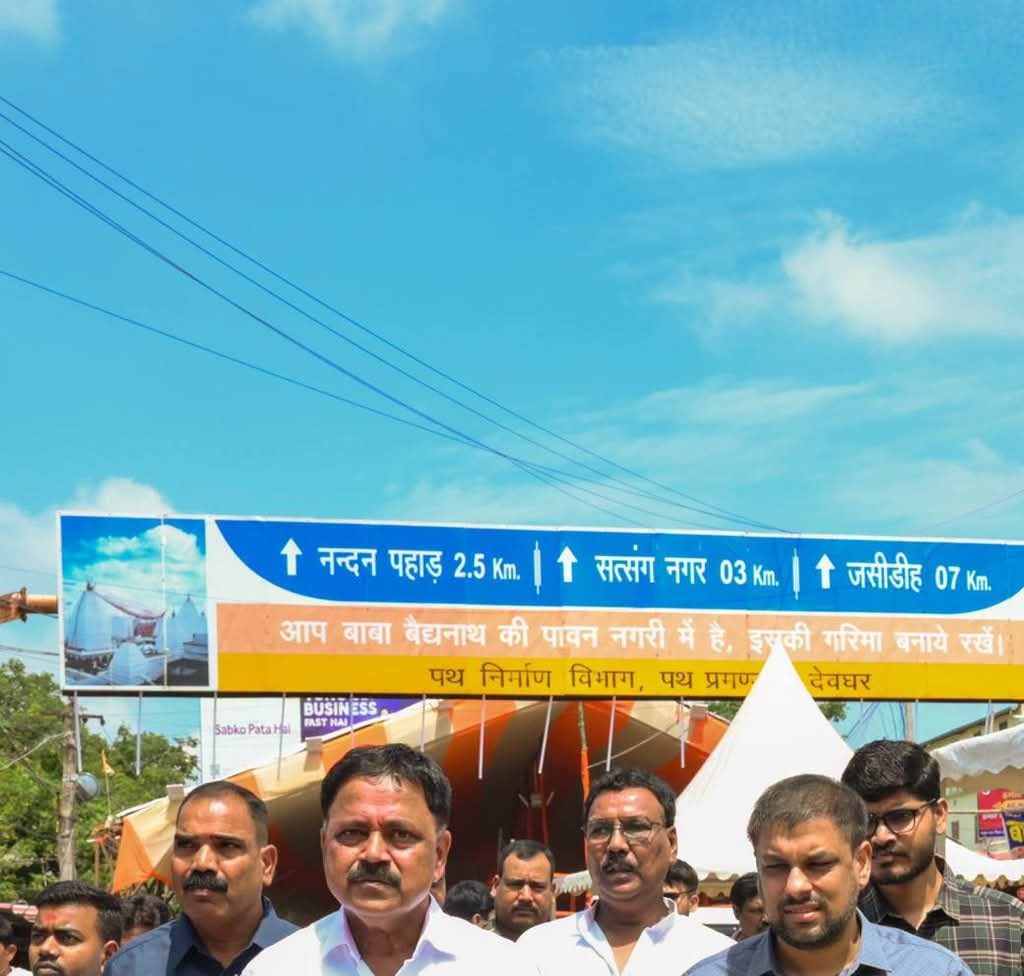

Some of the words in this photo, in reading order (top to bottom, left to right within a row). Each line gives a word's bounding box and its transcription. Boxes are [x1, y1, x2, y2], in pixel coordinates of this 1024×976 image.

[317, 547, 378, 577] नन्दन
[388, 548, 443, 584] पहाड़
[453, 552, 486, 579] 2.5
[492, 558, 521, 580] Km.
[594, 544, 656, 584] सत्संग
[665, 556, 708, 584] नगर
[719, 559, 748, 585] 03
[752, 564, 780, 587] Km.
[846, 552, 923, 593] जसीडीह
[935, 566, 961, 591] 07
[966, 570, 992, 591] Km.
[279, 619, 327, 645] आप
[341, 621, 392, 645] बाबा
[403, 614, 487, 647] बैद्यनाथ
[498, 616, 529, 647] की
[541, 626, 598, 648] पावन
[609, 617, 665, 649] नगरी
[677, 617, 695, 650] में
[749, 621, 811, 654] इसकी
[822, 622, 883, 653] गरिमा
[896, 625, 949, 654] बनाये
[429, 667, 465, 687] पथ
[480, 662, 552, 689] निर्माण
[660, 670, 693, 688] पथ
[808, 666, 872, 690] देवघर
[303, 701, 378, 716] BUSINESS
[304, 717, 327, 727] FAST
[329, 717, 348, 727] HAI
[215, 724, 247, 736] Sabko
[248, 725, 272, 735] Pata
[273, 724, 291, 735] Hai
